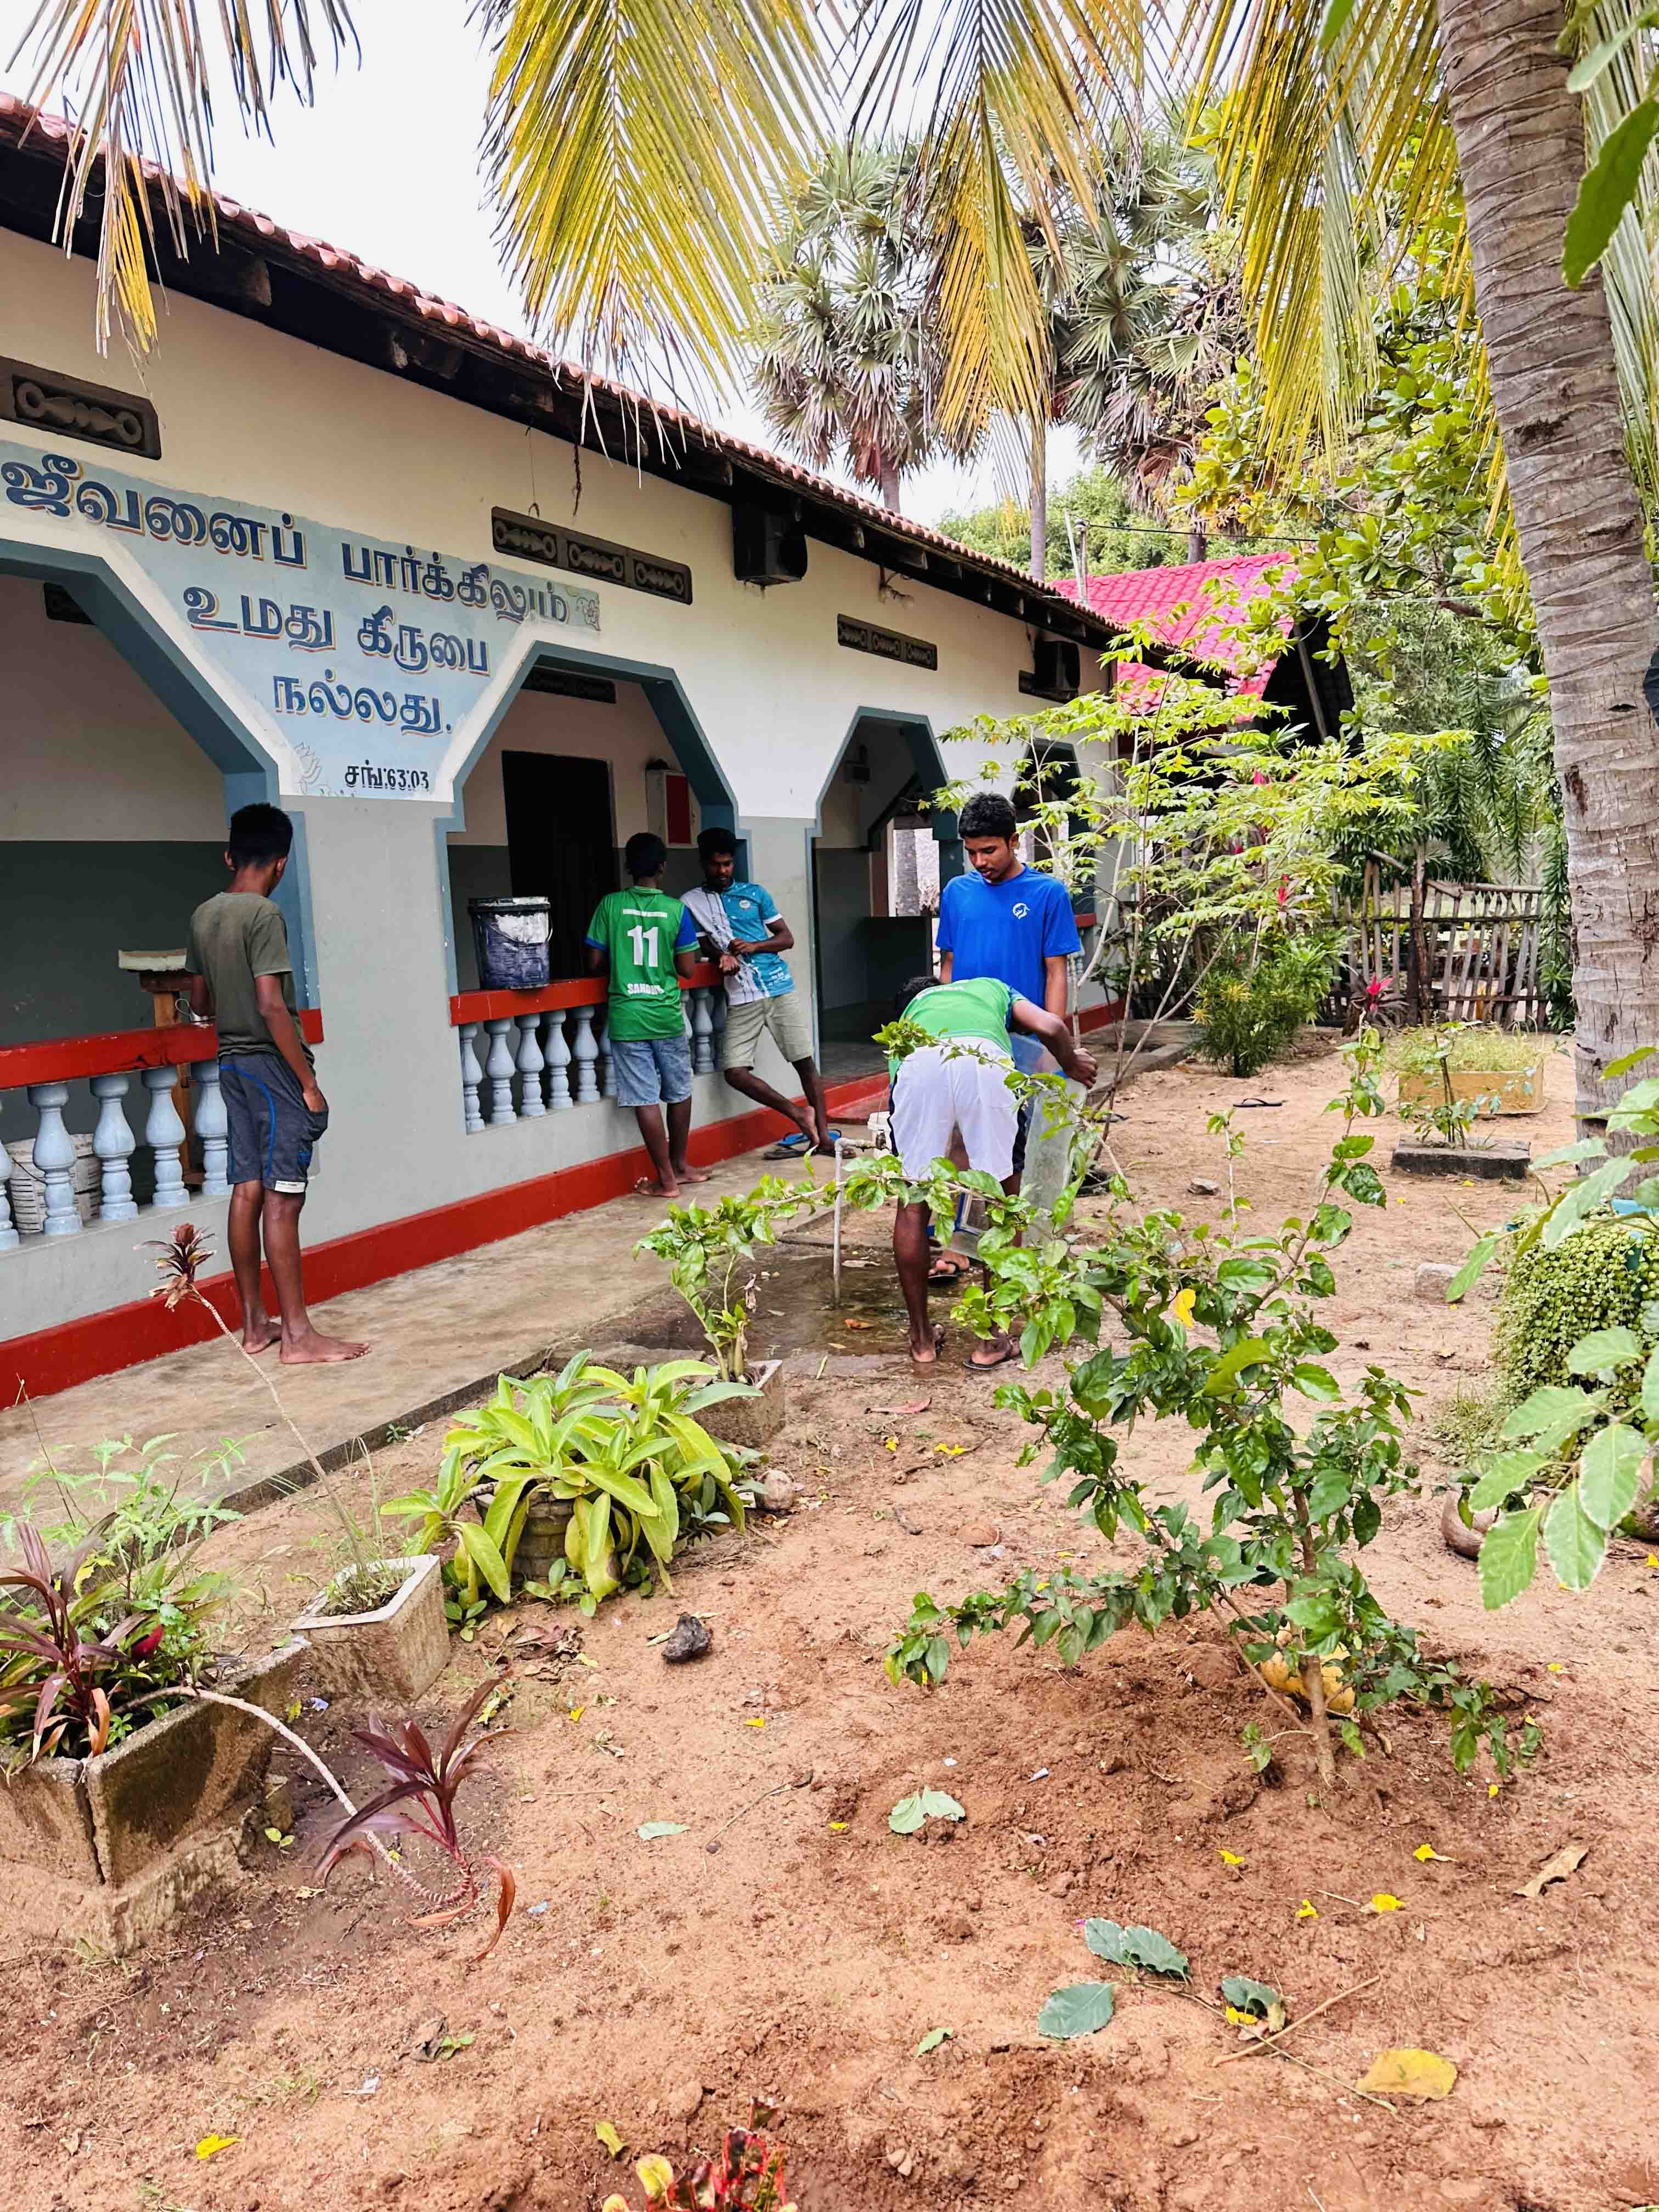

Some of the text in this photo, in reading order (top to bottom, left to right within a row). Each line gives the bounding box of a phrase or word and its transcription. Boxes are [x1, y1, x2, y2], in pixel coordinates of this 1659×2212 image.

[1, 454, 569, 624] ஜீவனைப் பார்க்கிலும்
[183, 586, 490, 676] உமது கிருபை
[273, 668, 452, 737] நல்லது.
[627, 925, 659, 967] 11
